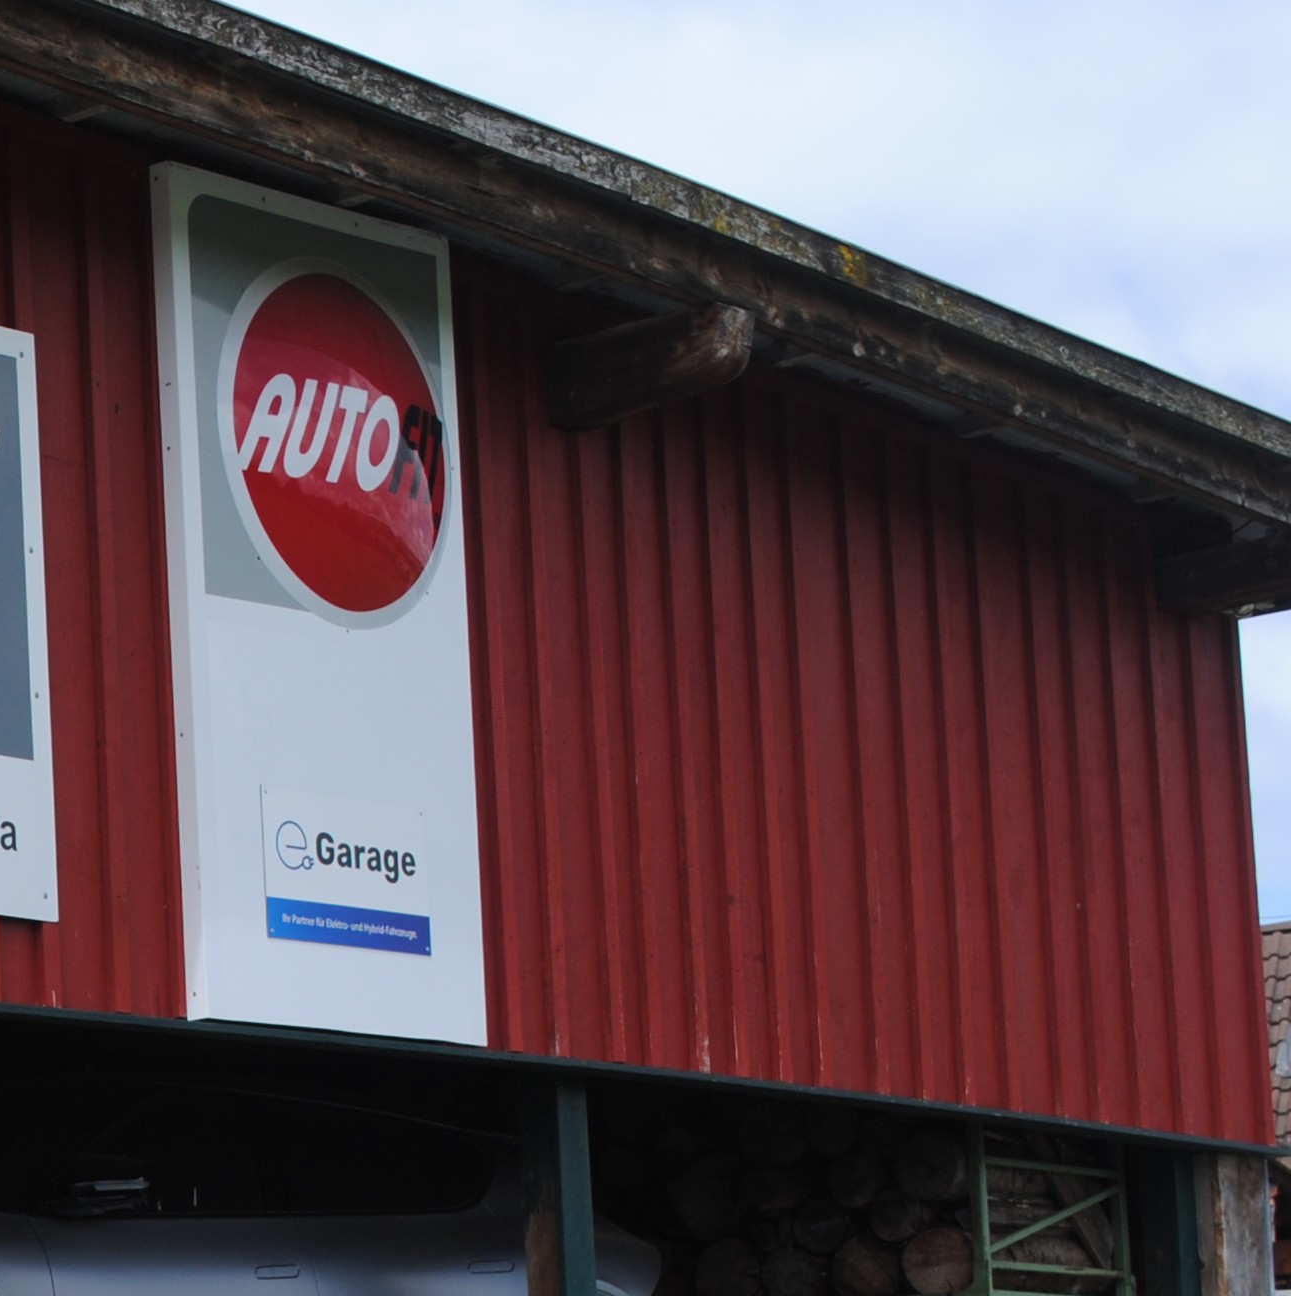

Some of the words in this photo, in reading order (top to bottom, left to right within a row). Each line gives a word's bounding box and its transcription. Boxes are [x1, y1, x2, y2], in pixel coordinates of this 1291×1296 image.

[316, 831, 416, 884] Garage
[292, 913, 315, 927] Partner
[316, 916, 325, 928] für
[350, 921, 363, 932] und
